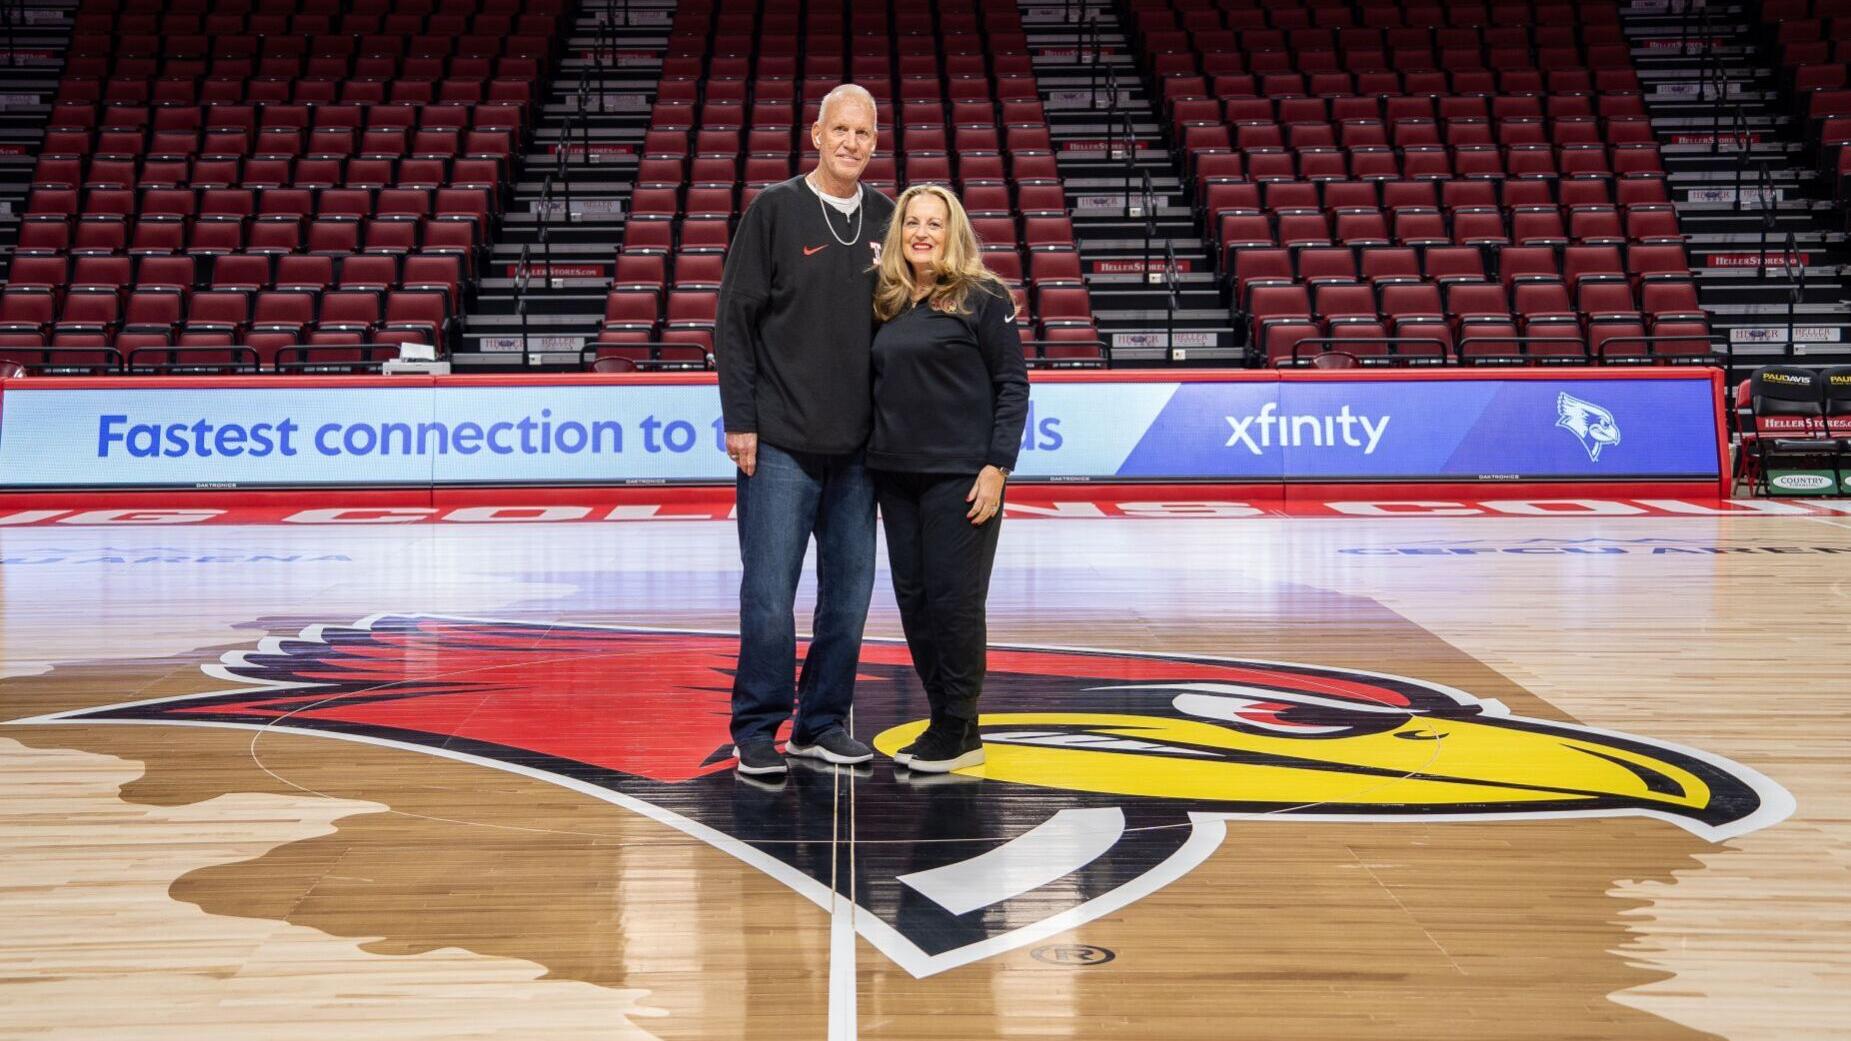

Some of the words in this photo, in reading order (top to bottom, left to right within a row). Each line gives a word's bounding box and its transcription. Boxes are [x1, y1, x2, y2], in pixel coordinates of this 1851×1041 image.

[98, 415, 298, 458] Fastest
[314, 407, 623, 456] connection
[639, 414, 697, 454] to
[1225, 401, 1391, 456] xfinity
